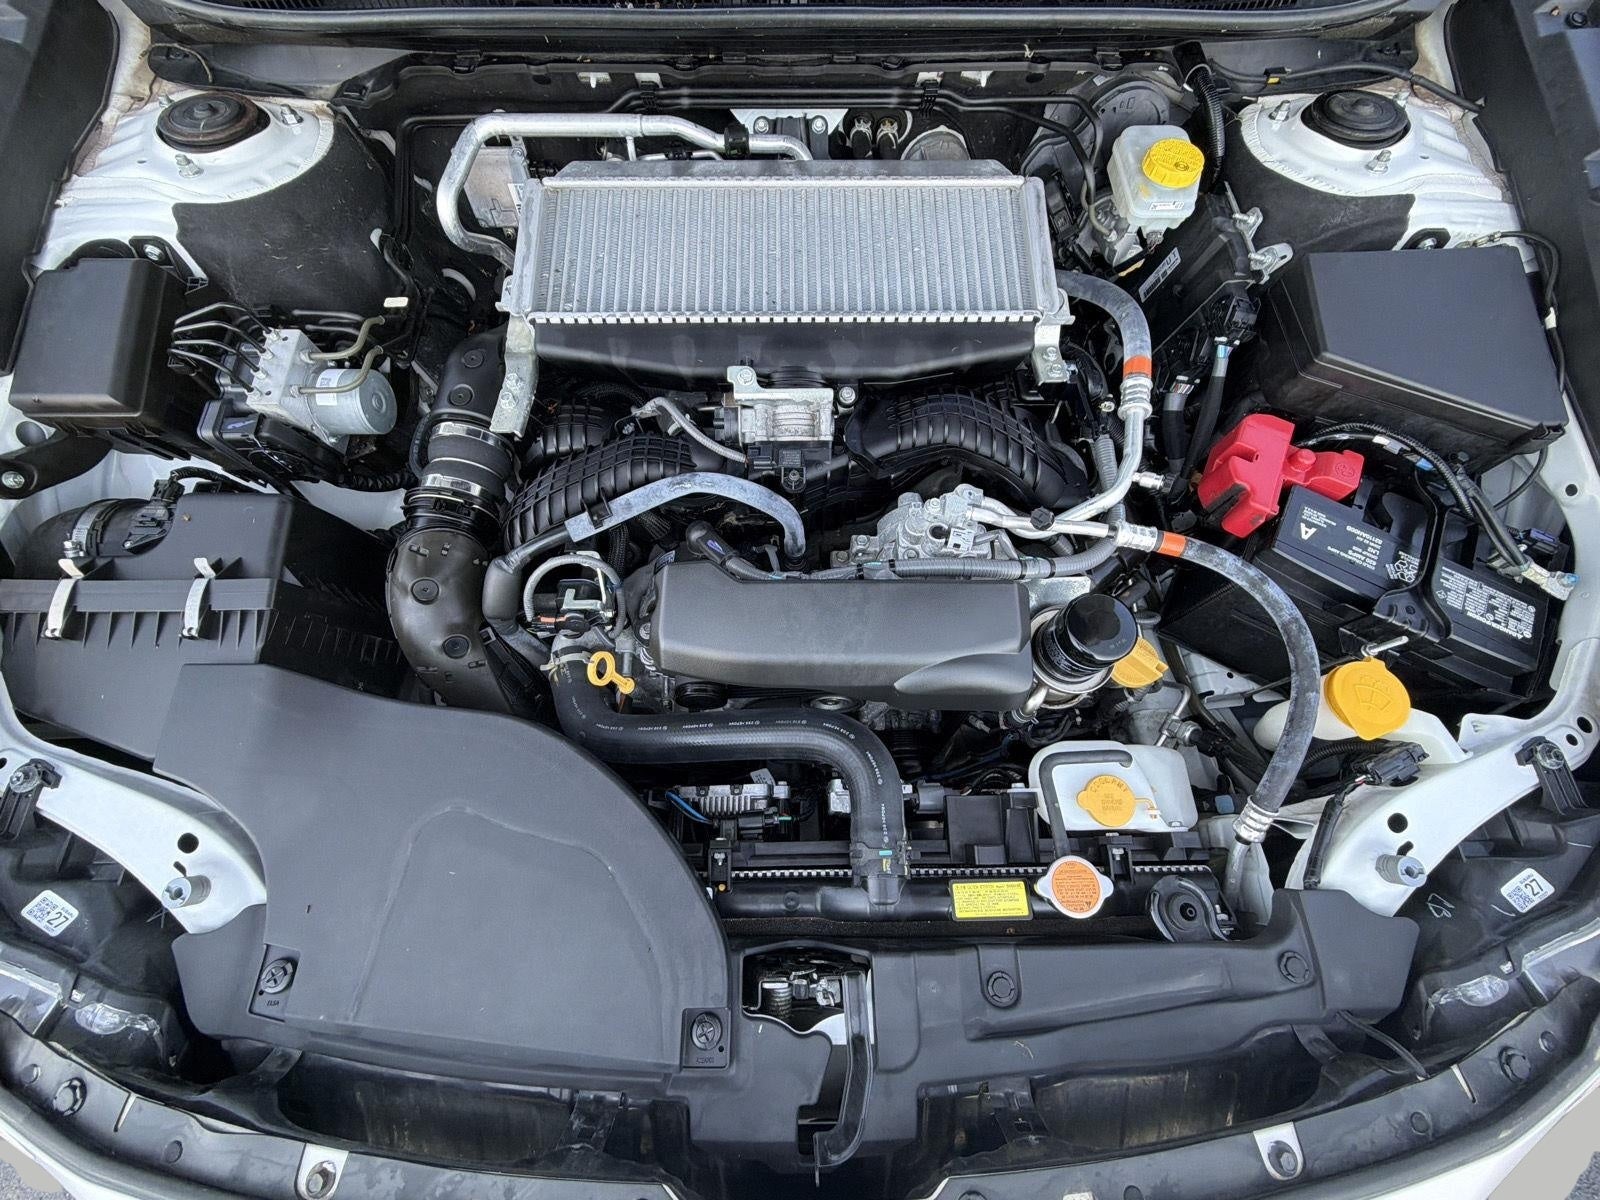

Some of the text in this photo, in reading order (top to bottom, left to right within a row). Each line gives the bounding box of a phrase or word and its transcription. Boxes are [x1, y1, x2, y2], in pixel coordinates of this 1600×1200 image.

[1300, 522, 1317, 540] A
[1347, 549, 1365, 560] AMPS
[1366, 546, 1379, 555] LN2
[1524, 878, 1543, 896] 27
[46, 911, 69, 928] 27
